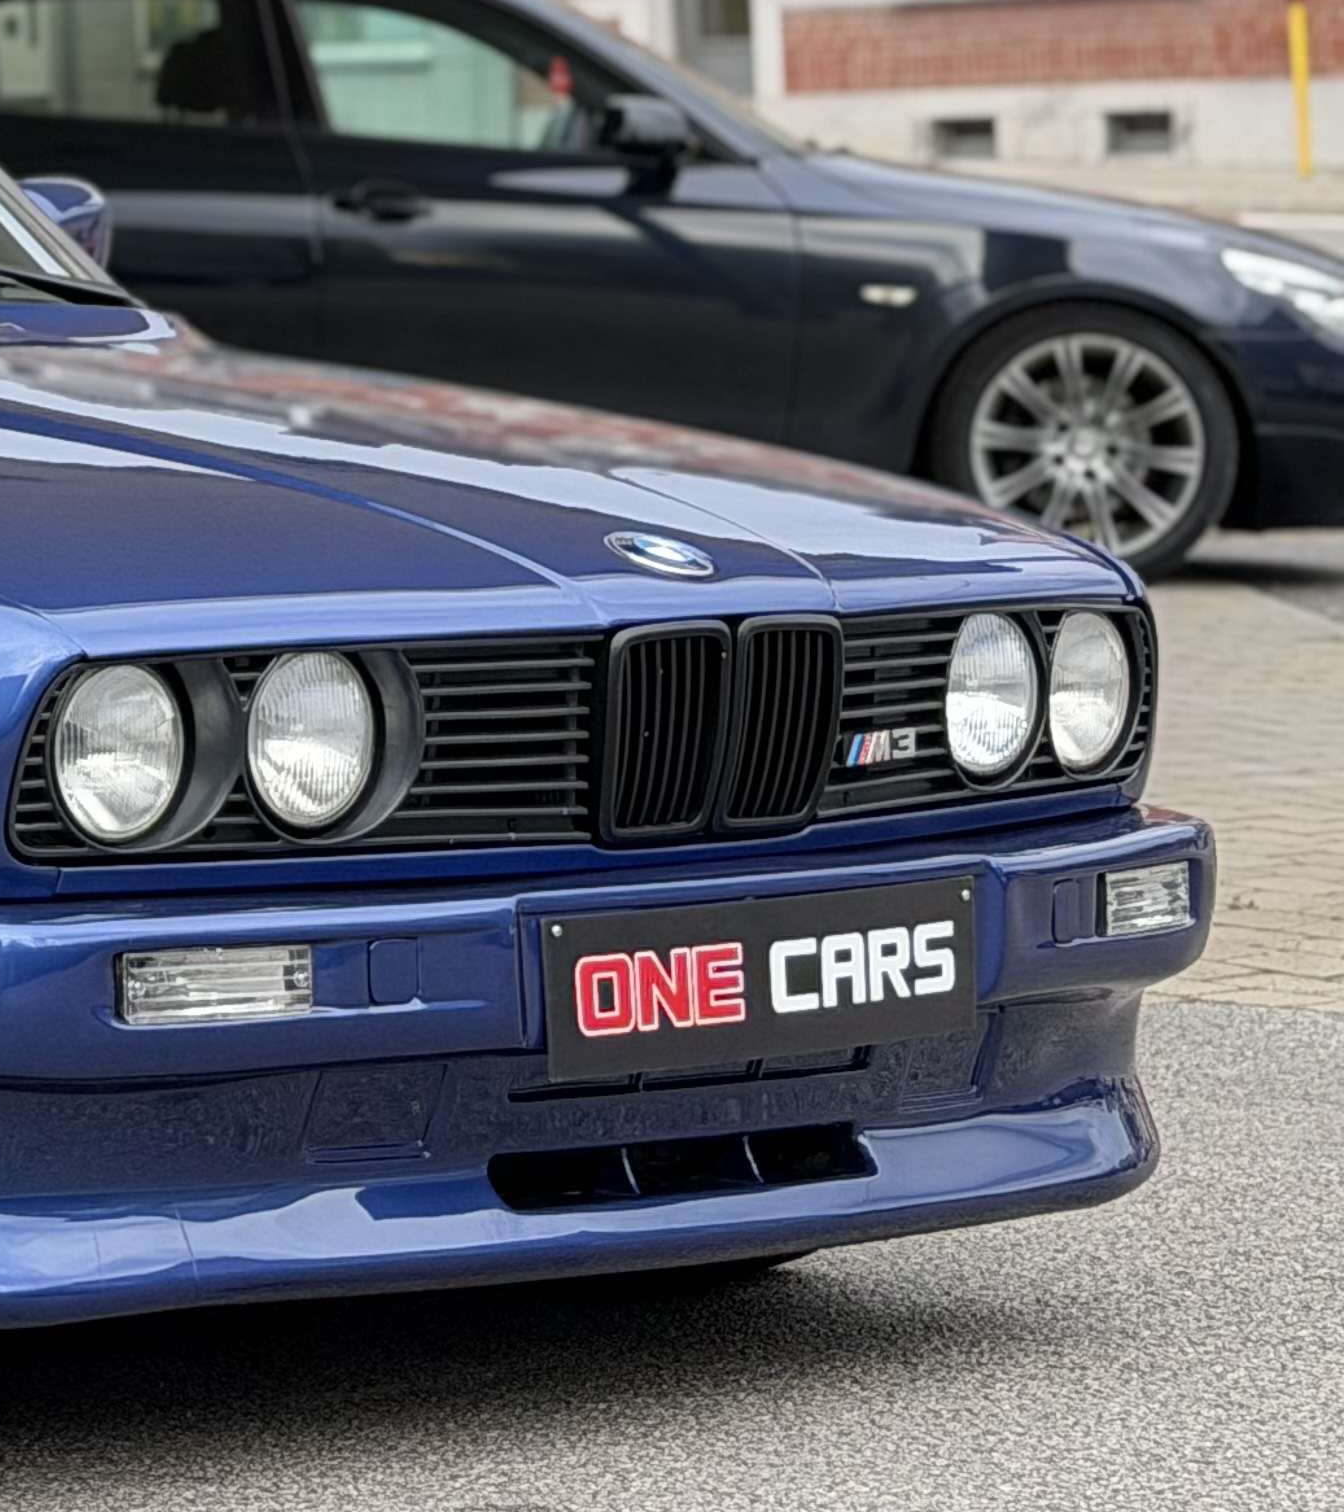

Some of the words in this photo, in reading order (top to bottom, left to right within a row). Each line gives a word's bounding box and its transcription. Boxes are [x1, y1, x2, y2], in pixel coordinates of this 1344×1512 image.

[864, 727, 916, 766] M3
[575, 942, 746, 1037] ONE
[769, 920, 955, 1014] CARS
